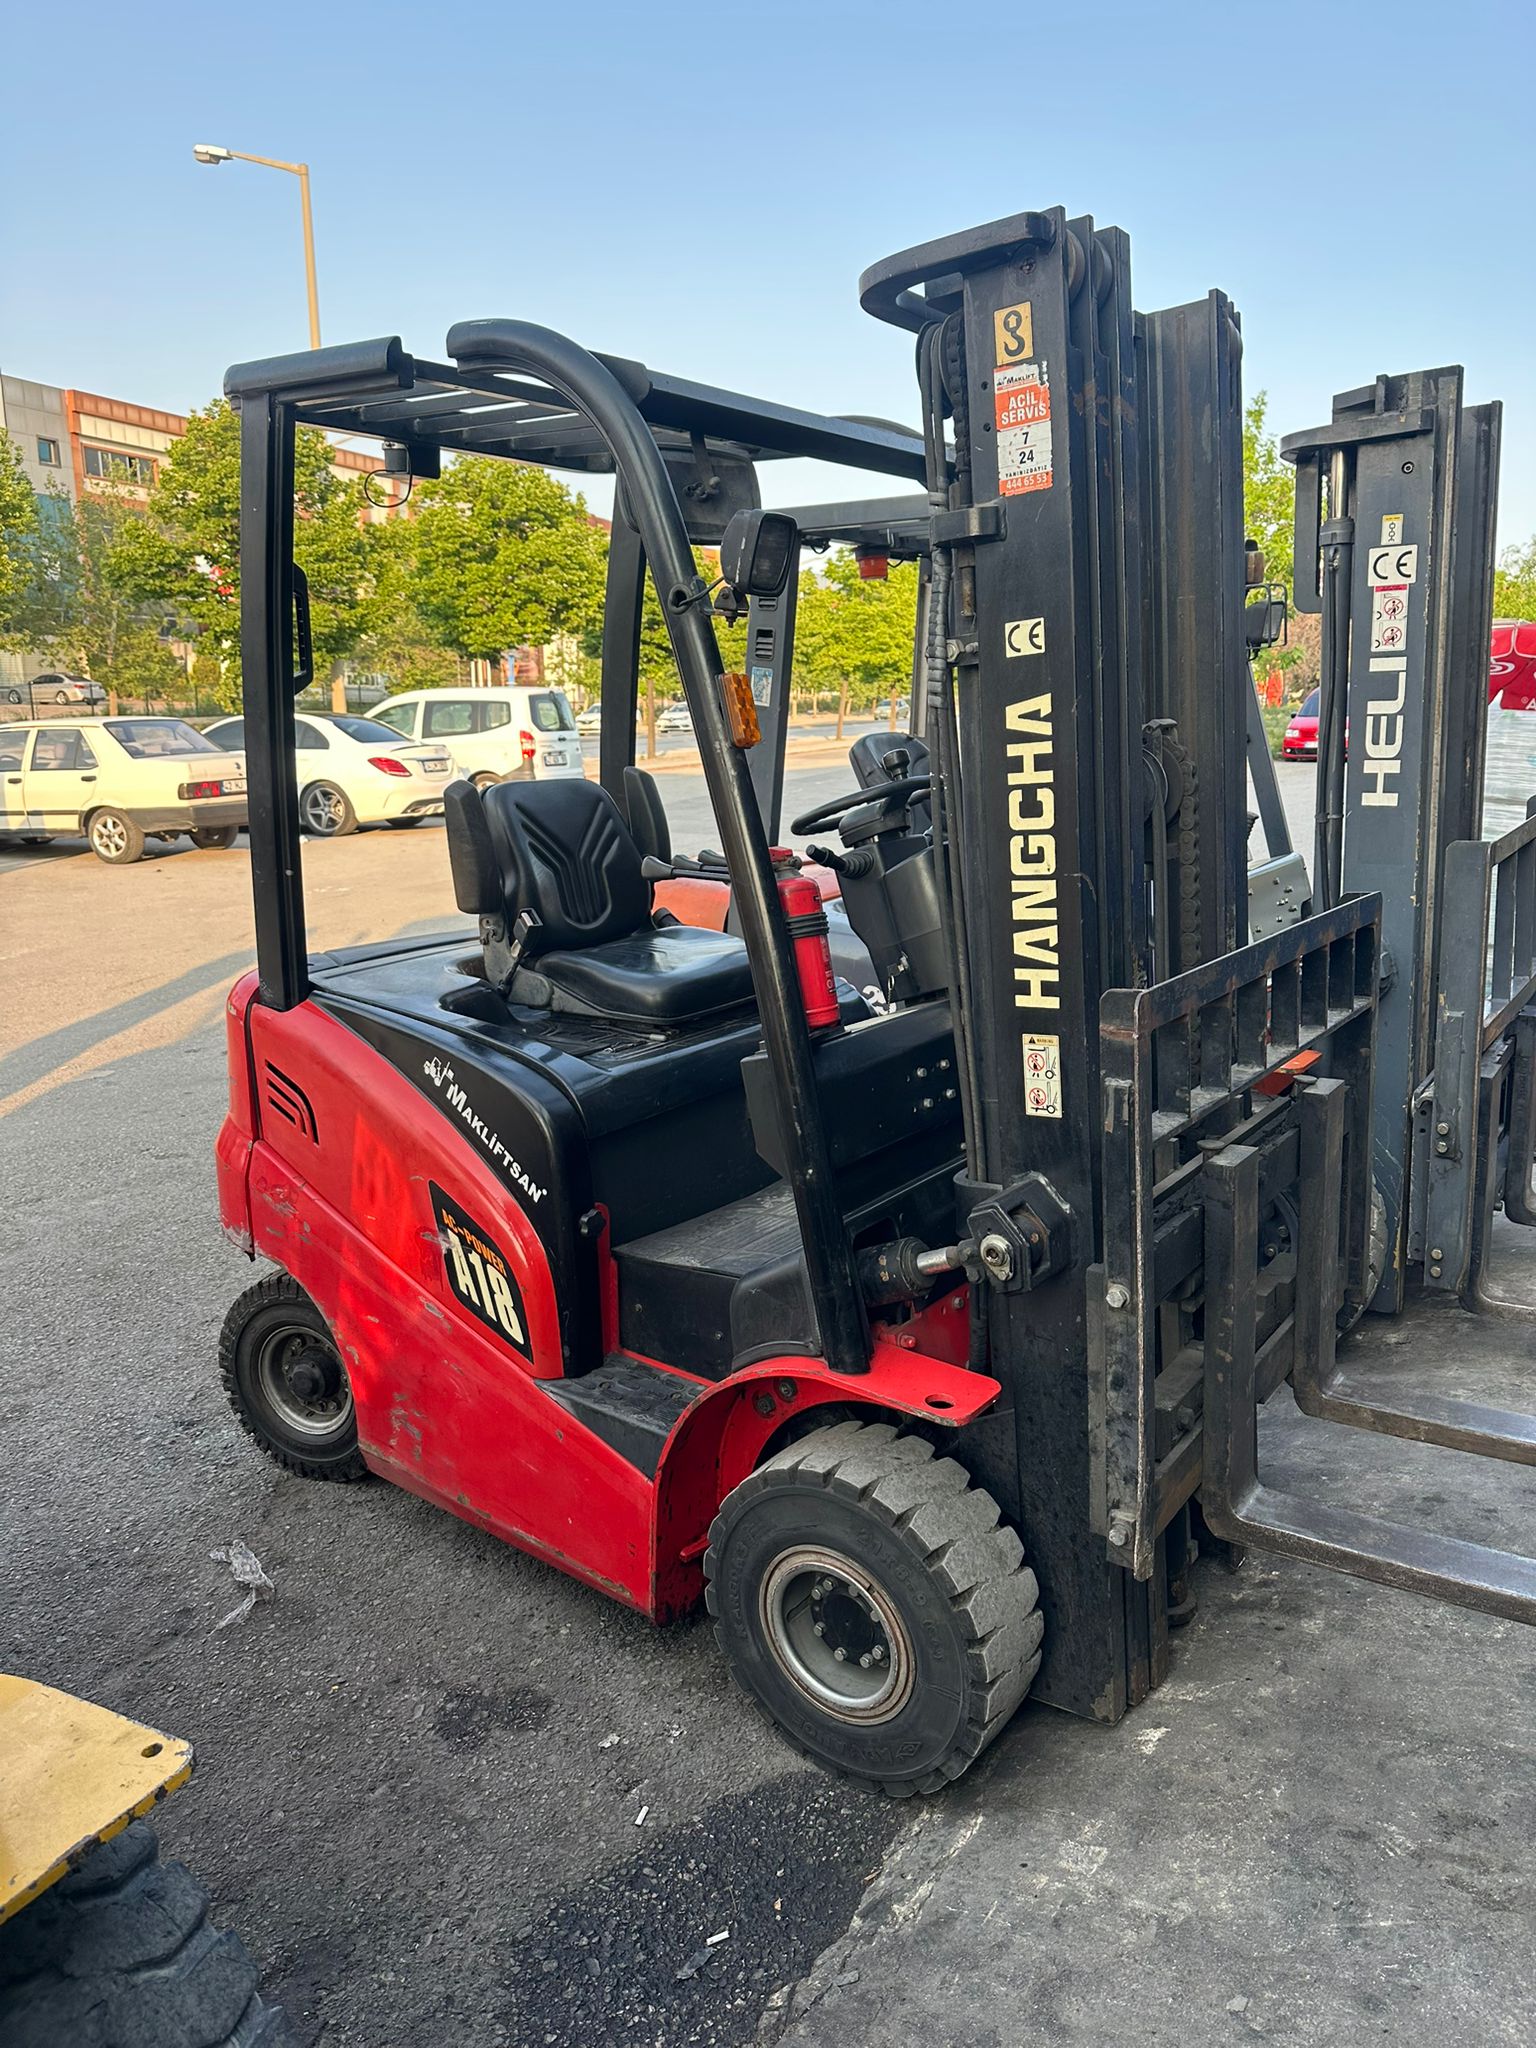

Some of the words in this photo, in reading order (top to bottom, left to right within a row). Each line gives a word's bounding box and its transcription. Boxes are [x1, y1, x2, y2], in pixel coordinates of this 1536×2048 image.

[1001, 403, 1047, 425] SERVİS
[1008, 389, 1038, 410] ACİL
[1022, 431, 1030, 445] 7
[1019, 449, 1035, 465] 24
[1006, 478, 1022, 490] 444
[1023, 475, 1035, 486] 65
[1036, 472, 1048, 484] 53
[1373, 550, 1413, 580] CE
[1008, 620, 1042, 654] CE
[1361, 656, 1408, 807] HELI
[1005, 692, 1061, 1010] HANGCHA
[441, 1208, 507, 1278] AC-POWER
[447, 1227, 525, 1346] A18
